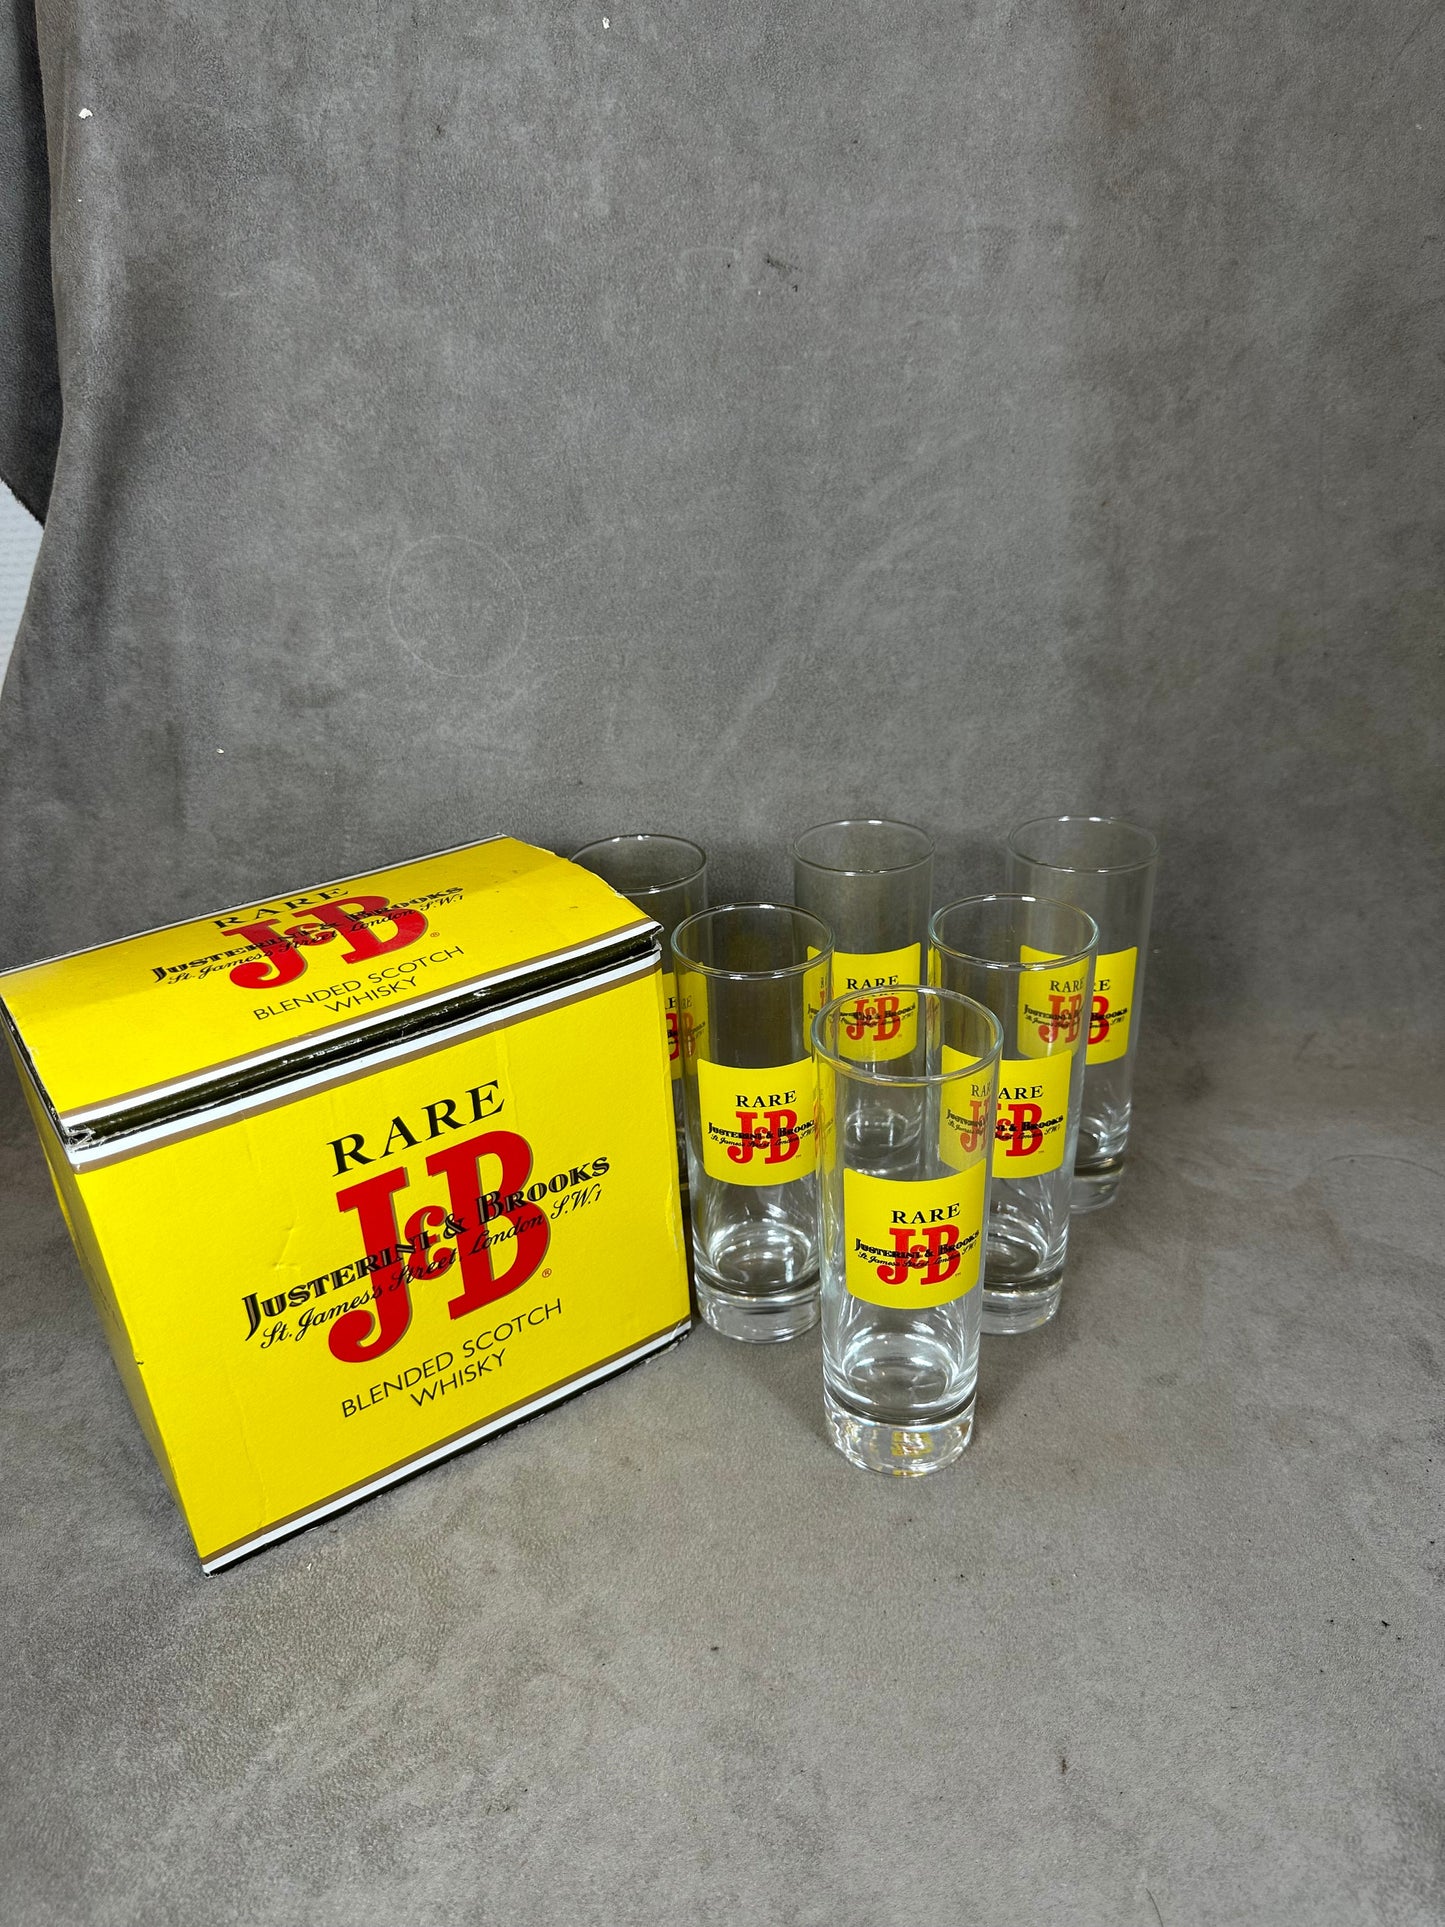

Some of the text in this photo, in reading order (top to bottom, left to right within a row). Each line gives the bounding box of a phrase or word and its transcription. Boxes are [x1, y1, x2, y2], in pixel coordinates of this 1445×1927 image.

[213, 887, 349, 928] RARE
[344, 887, 463, 921] BROOKS
[351, 909, 416, 931] London
[222, 895, 429, 989] J&B
[253, 945, 465, 1020] BLENDED SCOTCH
[324, 975, 418, 1013] WHISKY
[846, 995, 901, 1041] J&B
[735, 1090, 797, 1108] RARE
[997, 1085, 1044, 1100] ARE
[326, 1080, 505, 1177] RARE
[727, 1109, 800, 1164] J&B
[891, 1202, 960, 1224] RARE
[242, 1156, 610, 1341] JUSTERINI & BROOKS
[260, 1321, 293, 1349] St.
[468, 1213, 545, 1255] London
[550, 1183, 603, 1219] S.W.1
[328, 1130, 551, 1363] J&B
[877, 1224, 961, 1285] J&B
[341, 1297, 562, 1418] BLENDED SCOTCH
[410, 1348, 506, 1407] WHISKY
